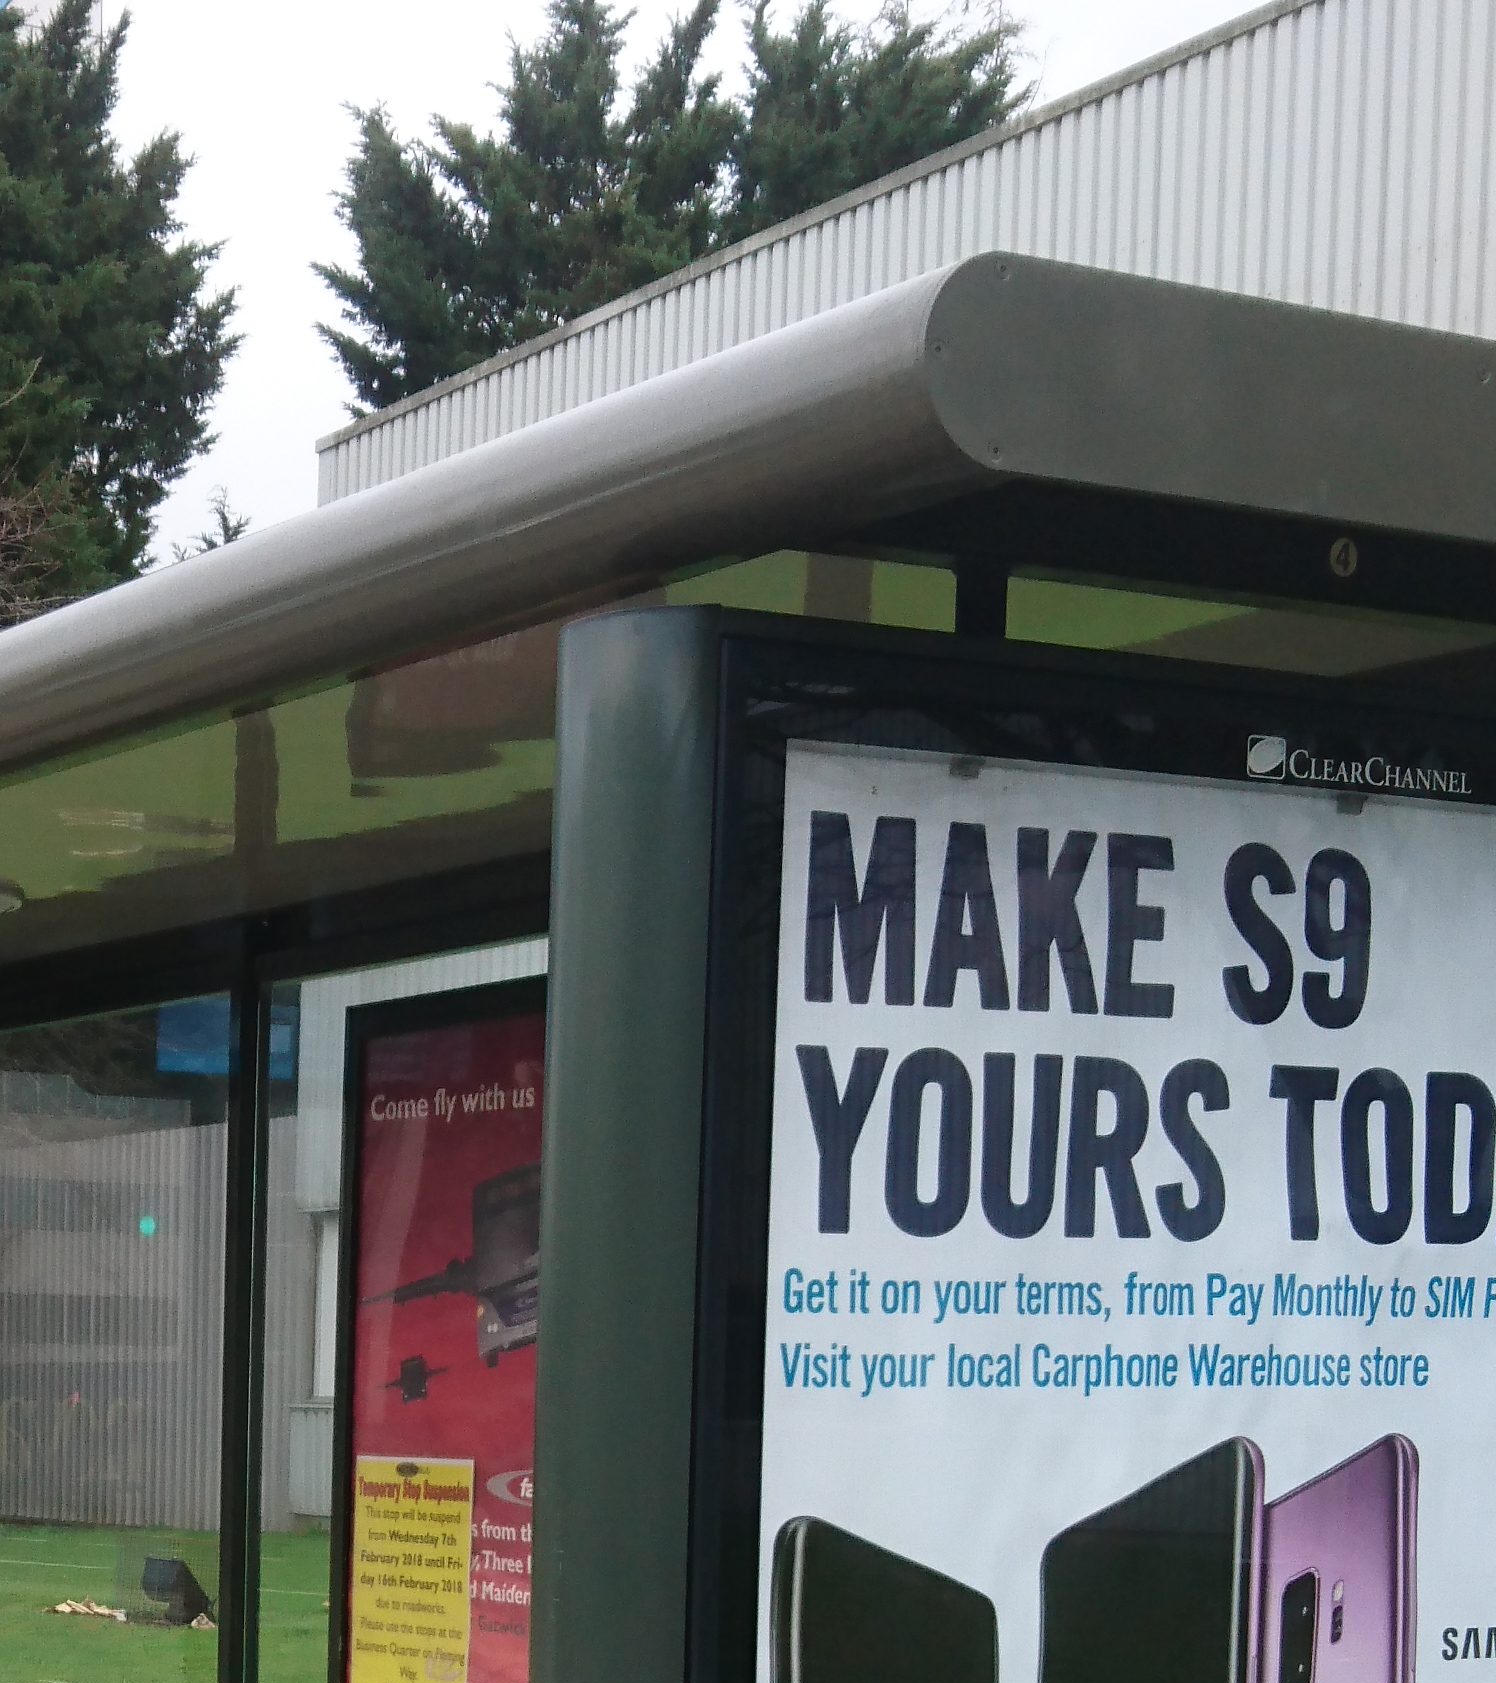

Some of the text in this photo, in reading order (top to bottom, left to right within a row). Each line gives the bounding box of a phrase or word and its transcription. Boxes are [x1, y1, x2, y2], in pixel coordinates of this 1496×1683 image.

[804, 810, 1372, 1029] MAKE S9
[370, 1082, 536, 1122] Come fly with us
[795, 1044, 1230, 1242] YOURS
[783, 1267, 838, 1315] Get
[849, 1268, 870, 1314] it
[881, 1278, 921, 1314] on
[933, 1279, 1007, 1324] your
[1014, 1272, 1111, 1323] terms,
[1124, 1271, 1194, 1317] from
[1207, 1272, 1264, 1326] Pay
[1272, 1273, 1383, 1327] Monthly
[1390, 1278, 1416, 1318] to
[1424, 1275, 1476, 1319] SIM
[780, 1342, 1429, 1397] Visit your local Carphone Warehouse store
[358, 1476, 401, 1504] Temporary
[402, 1478, 421, 1505] Stop
[365, 1505, 381, 1518] This
[383, 1509, 400, 1522] stop
[402, 1508, 415, 1521] will
[417, 1510, 428, 1521] be
[368, 1527, 457, 1548] from Wednesday 7th
[481, 1518, 517, 1541] from
[360, 1549, 399, 1567] February
[402, 1553, 423, 1567] 2018
[425, 1555, 445, 1568] until
[481, 1549, 523, 1573] Three
[360, 1571, 463, 1594] day 16th February 2018
[375, 1597, 389, 1609] due
[391, 1600, 400, 1610] to
[360, 1616, 384, 1631] Please
[386, 1623, 399, 1633] use
[401, 1622, 413, 1634] the
[415, 1625, 436, 1638] stops
[438, 1628, 447, 1639] at
[389, 1642, 421, 1657] Quarter
